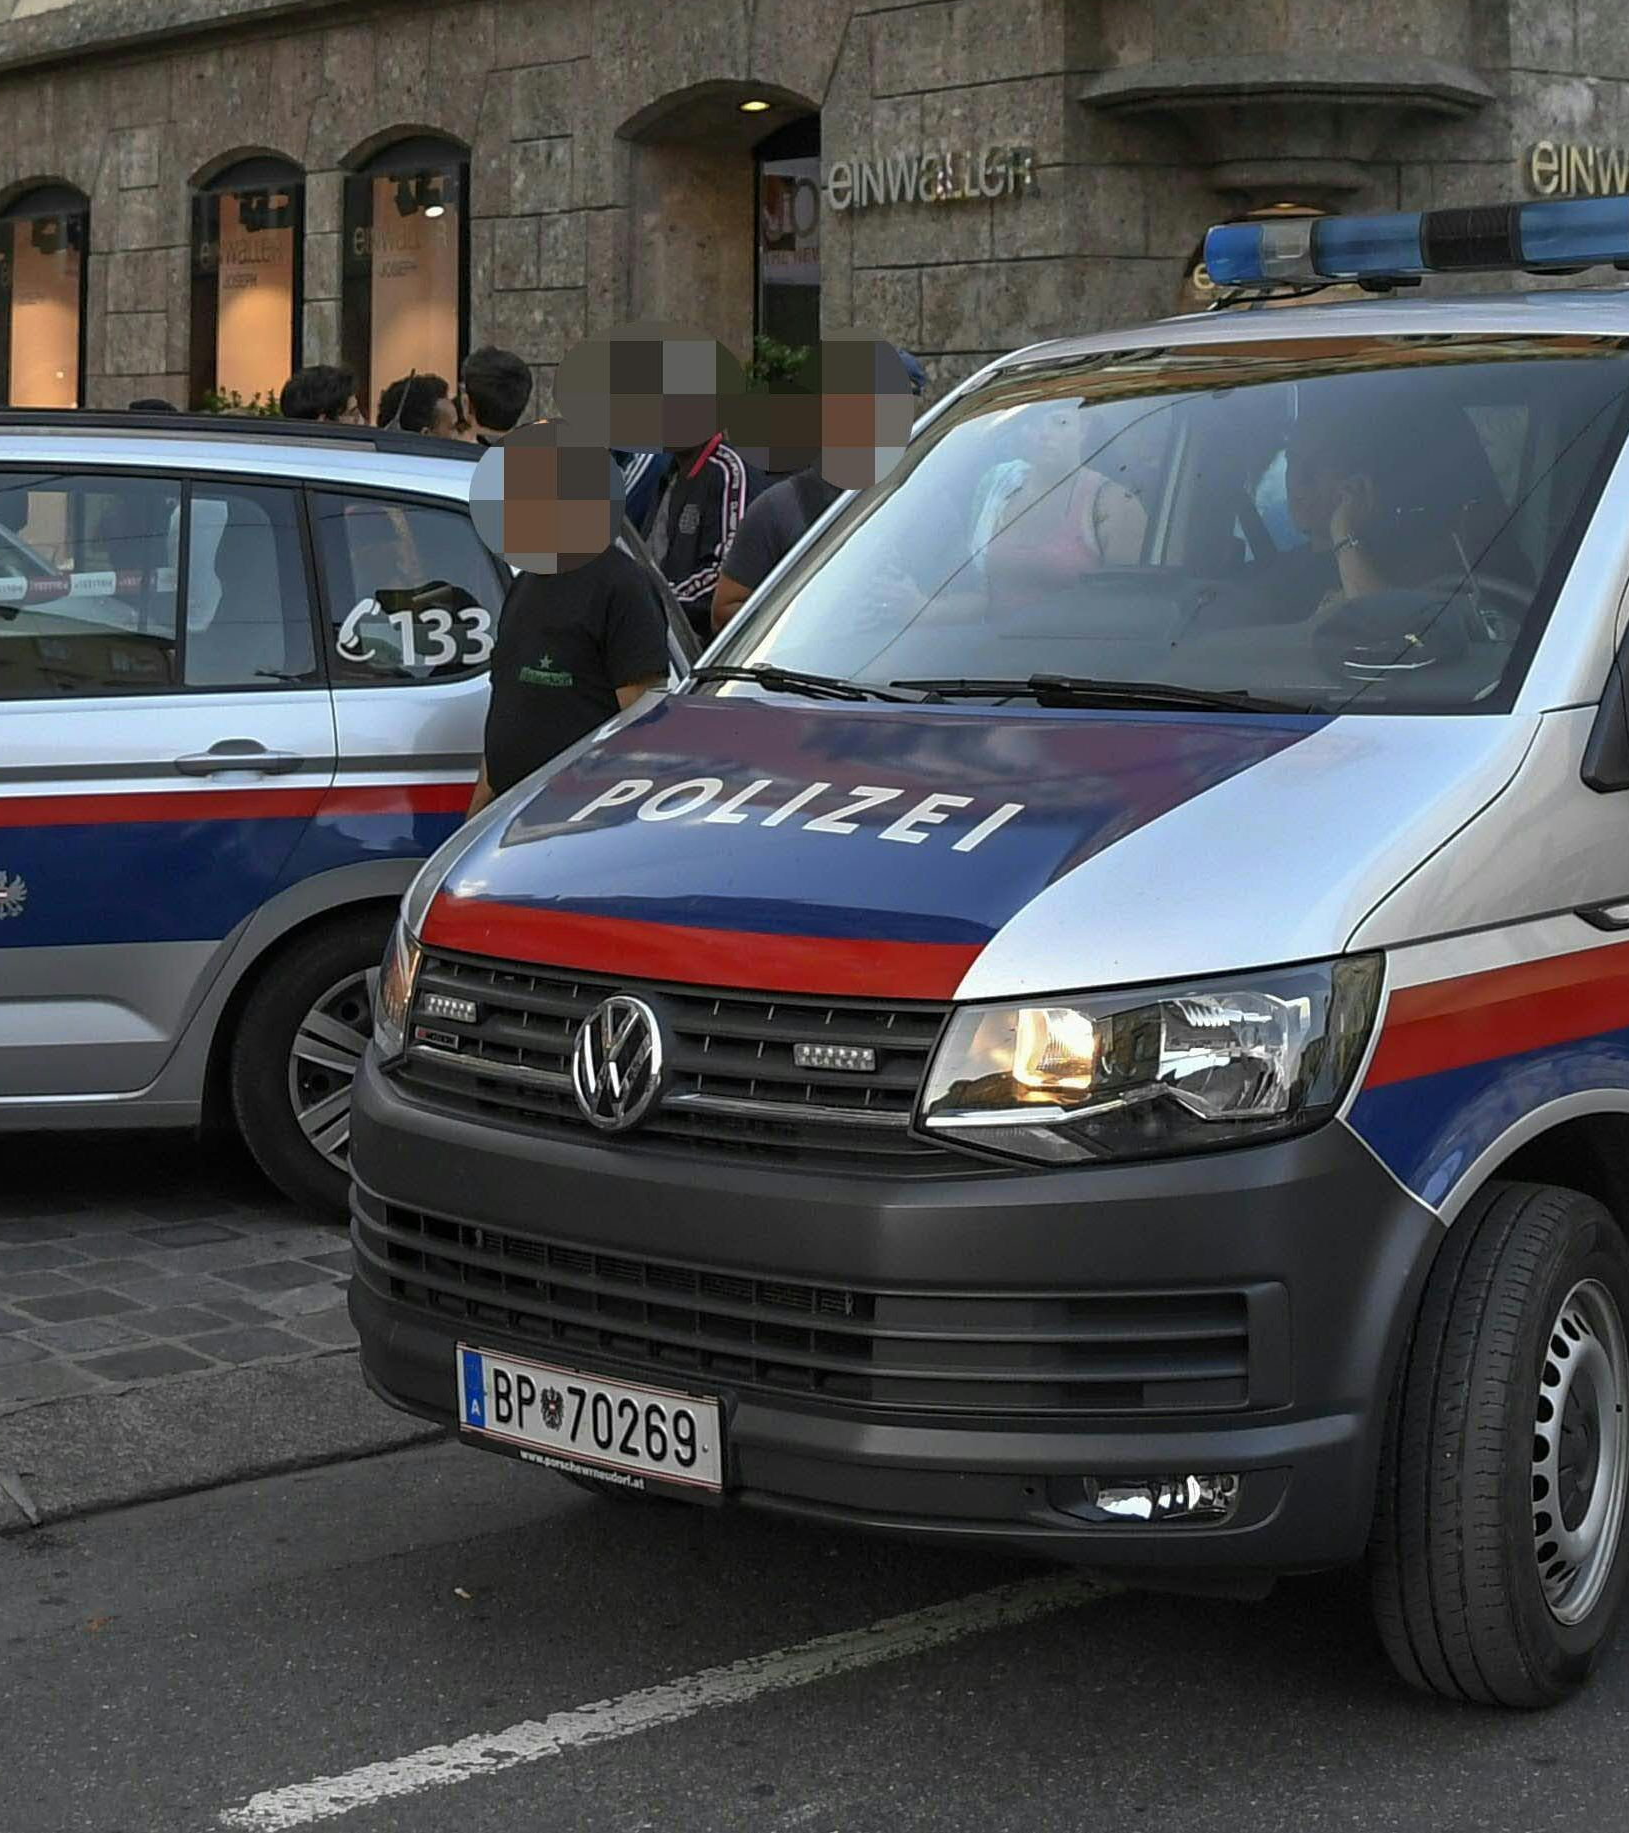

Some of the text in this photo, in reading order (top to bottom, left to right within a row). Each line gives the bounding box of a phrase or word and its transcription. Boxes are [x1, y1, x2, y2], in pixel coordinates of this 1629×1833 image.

[389, 606, 494, 666] 133
[570, 777, 1024, 855] POLIZEI
[493, 1367, 536, 1429] BP
[567, 1385, 697, 1468] 70269
